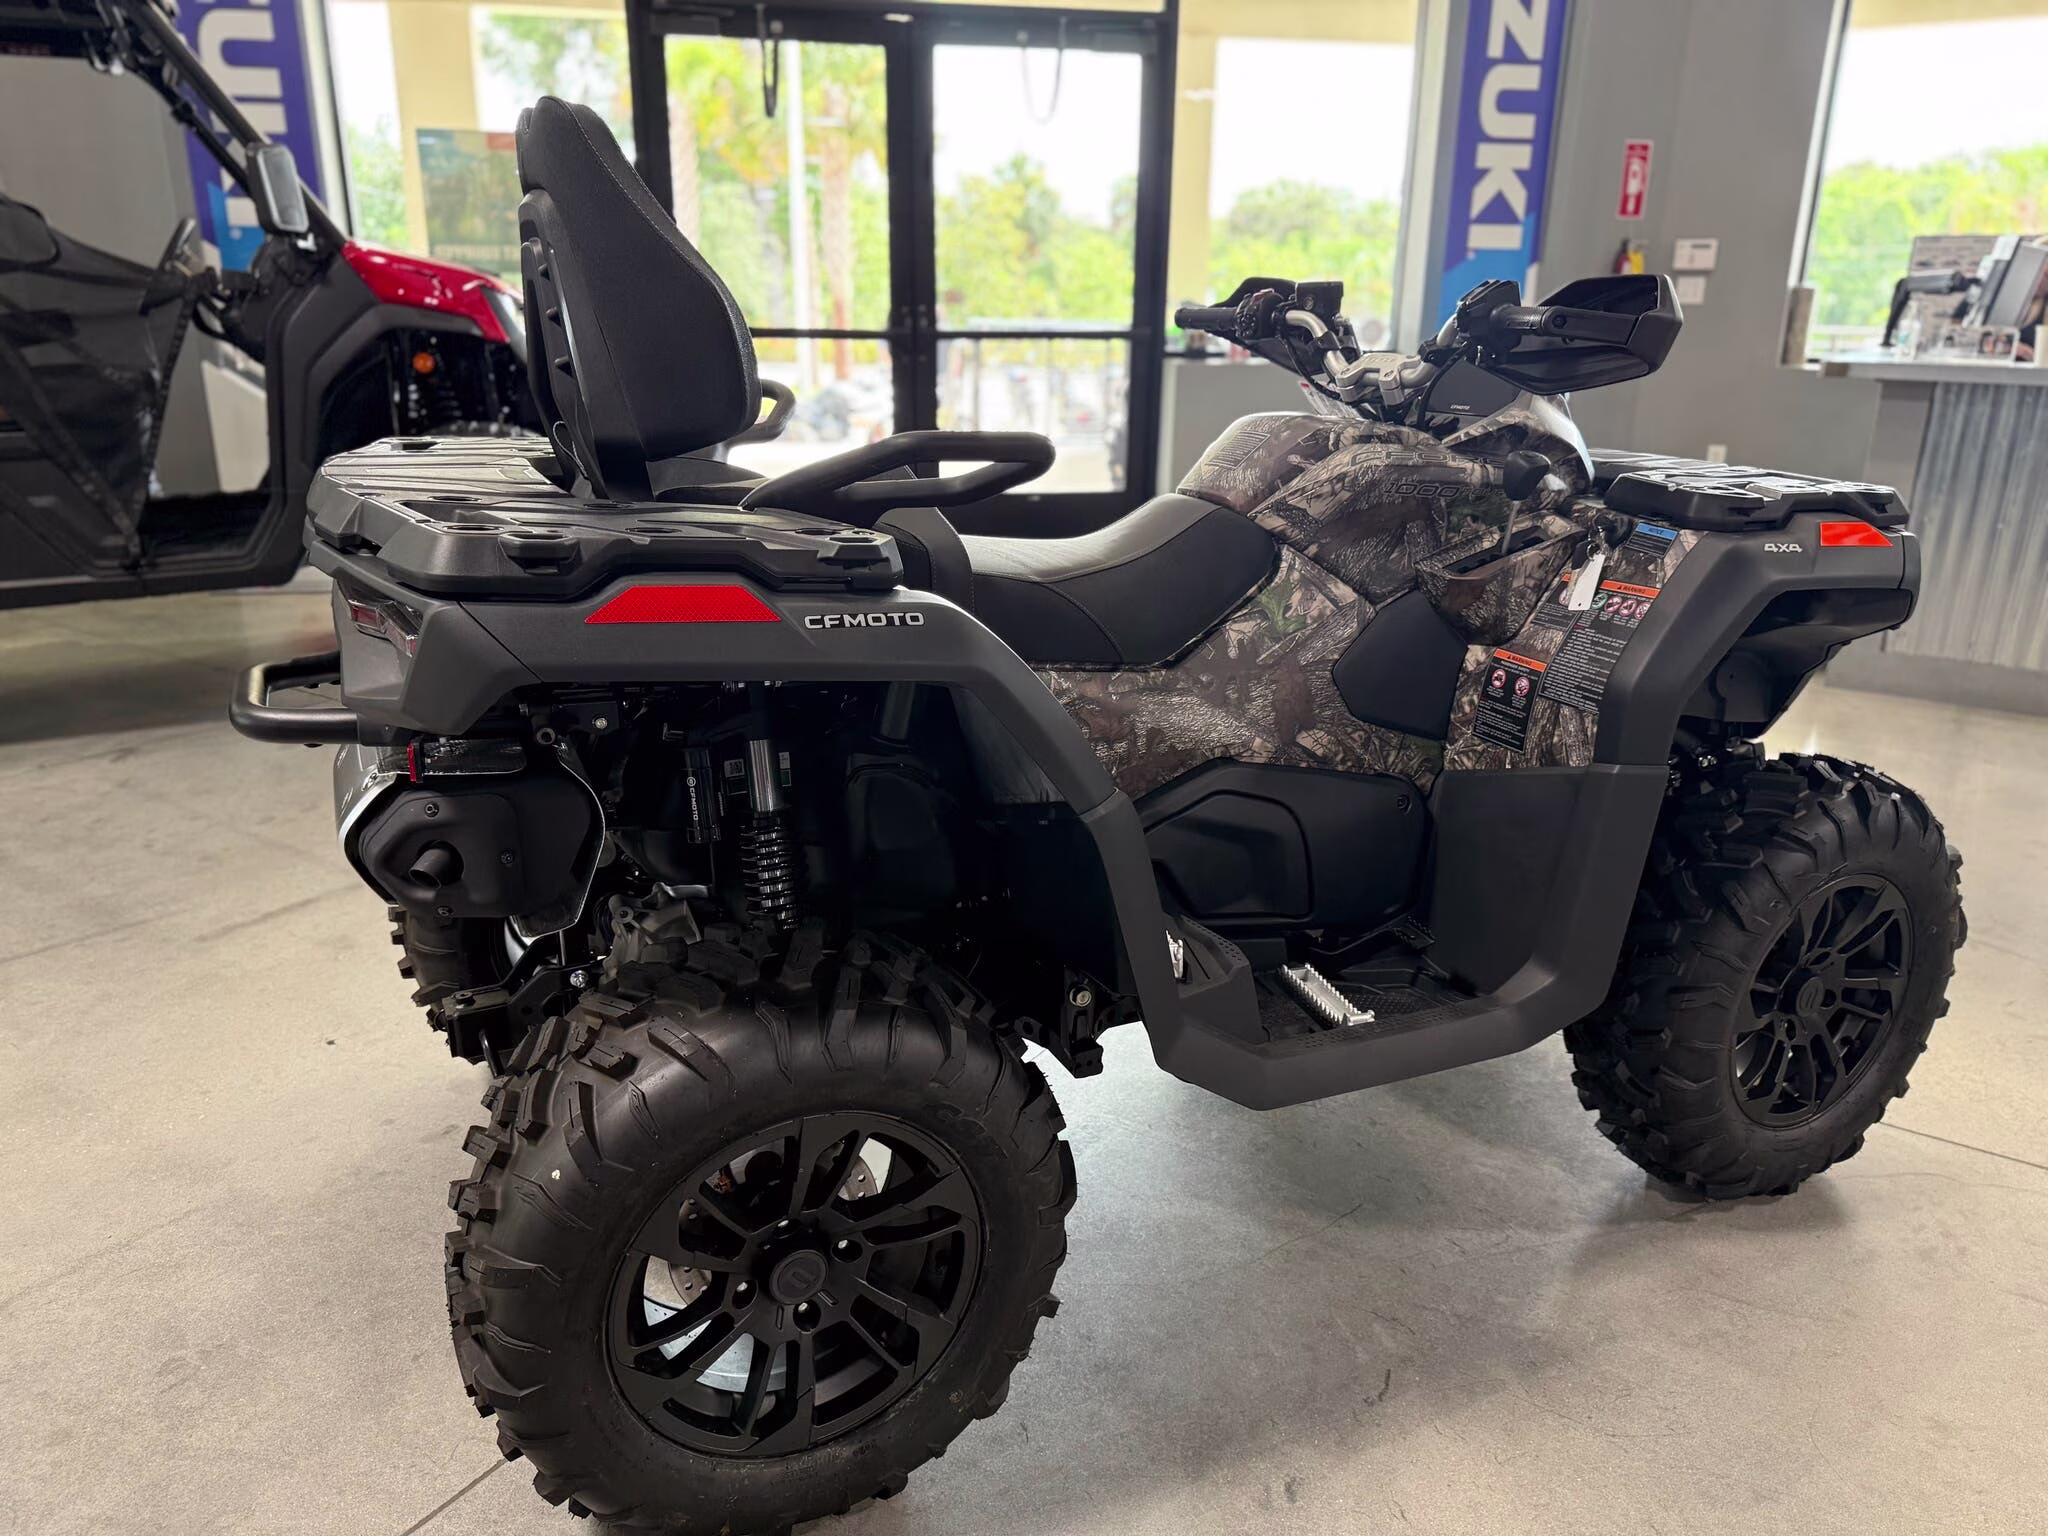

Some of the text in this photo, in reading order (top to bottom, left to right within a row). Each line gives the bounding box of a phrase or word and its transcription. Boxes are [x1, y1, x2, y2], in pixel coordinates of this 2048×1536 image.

[1384, 482, 1460, 497] 1000
[804, 612, 925, 629] CFMOTO
[689, 787, 699, 821] CFMOTO
